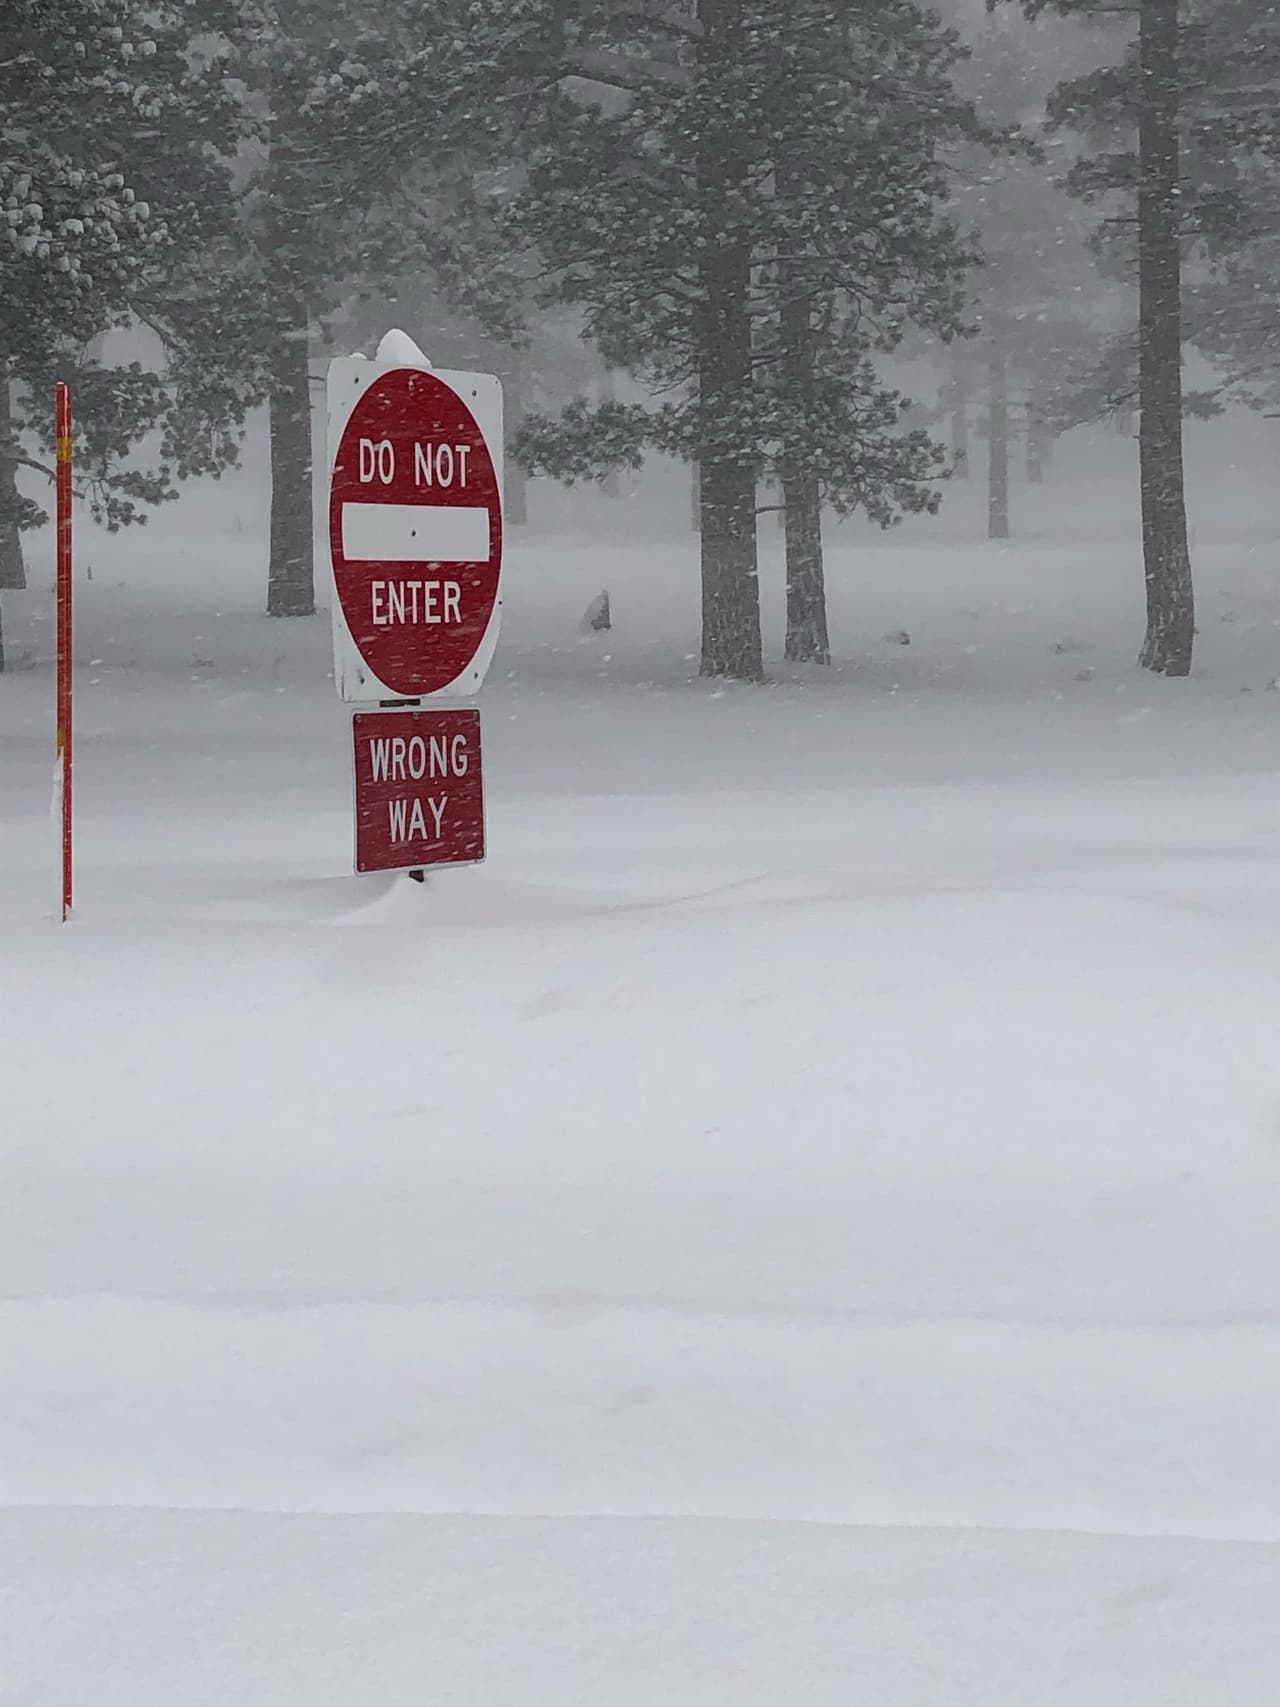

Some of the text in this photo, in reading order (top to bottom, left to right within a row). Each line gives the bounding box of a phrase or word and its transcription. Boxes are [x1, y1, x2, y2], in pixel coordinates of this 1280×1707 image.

[359, 438, 471, 488] DO NOT
[371, 581, 462, 625] ENTER
[369, 734, 468, 783] WRONG
[388, 796, 448, 843] WAY
